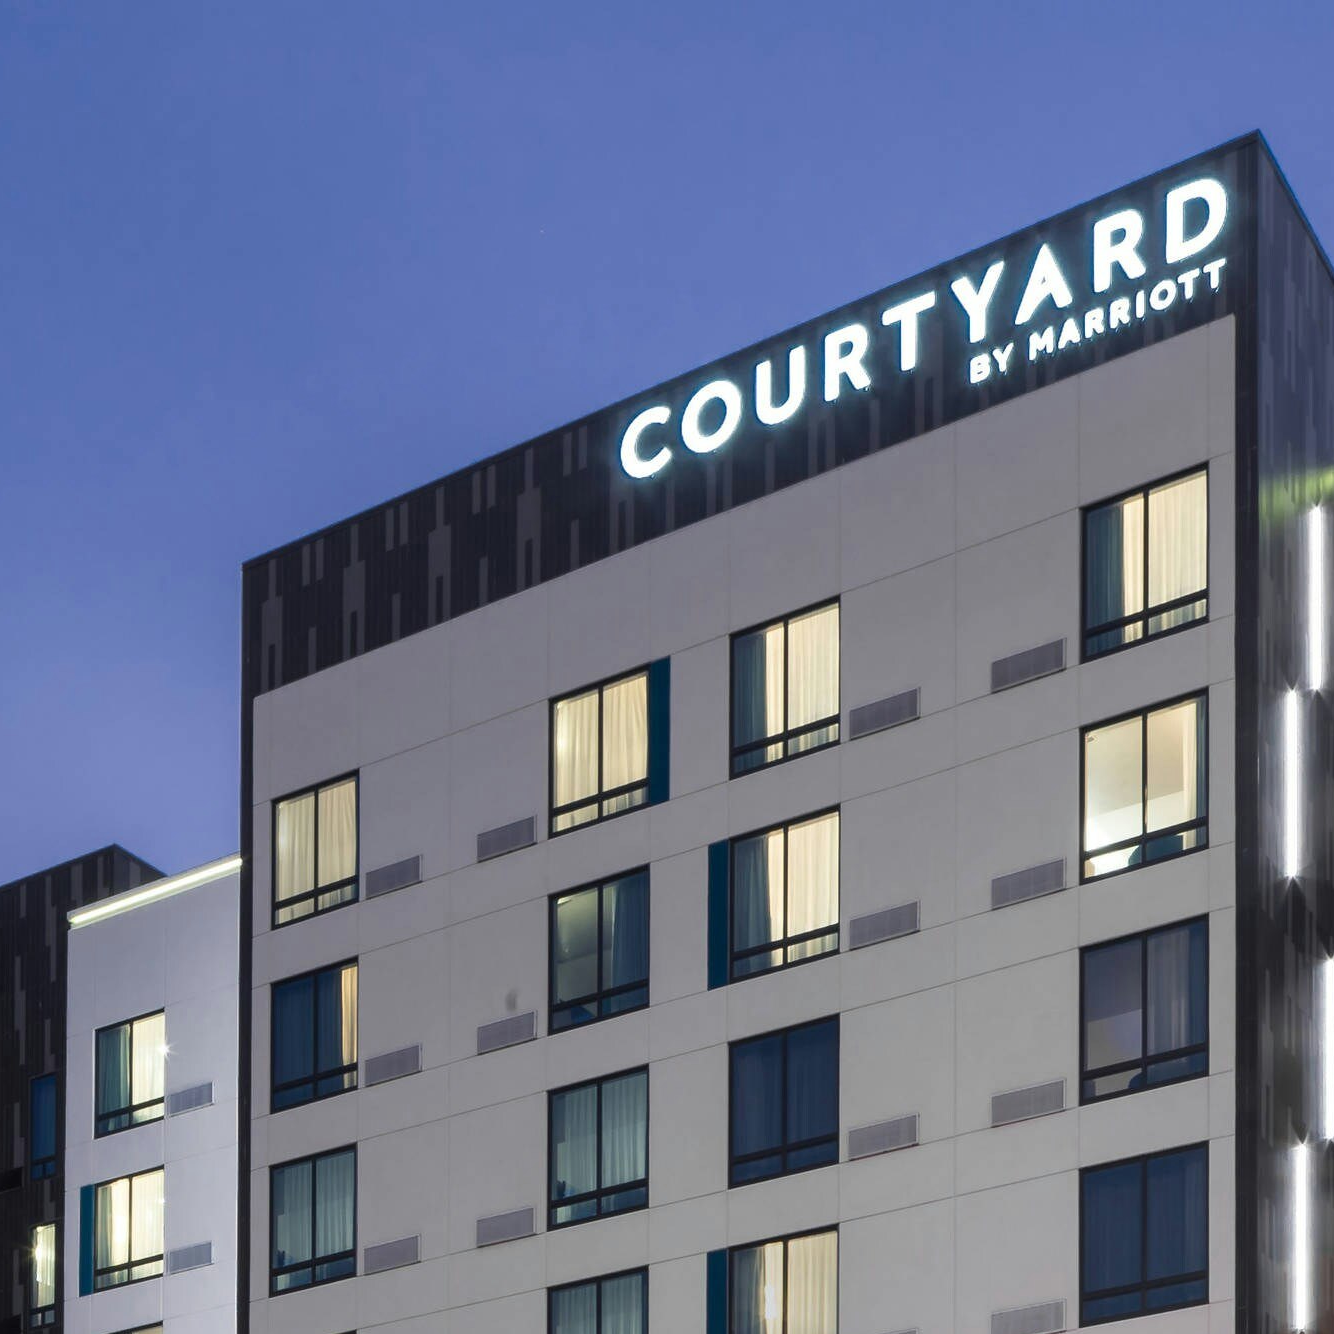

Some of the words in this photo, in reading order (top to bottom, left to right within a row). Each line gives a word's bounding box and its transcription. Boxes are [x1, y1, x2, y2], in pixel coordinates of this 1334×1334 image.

[619, 177, 1229, 480] COURTYARD
[969, 342, 1015, 384] BY
[1028, 257, 1227, 362] MARRIOTT
